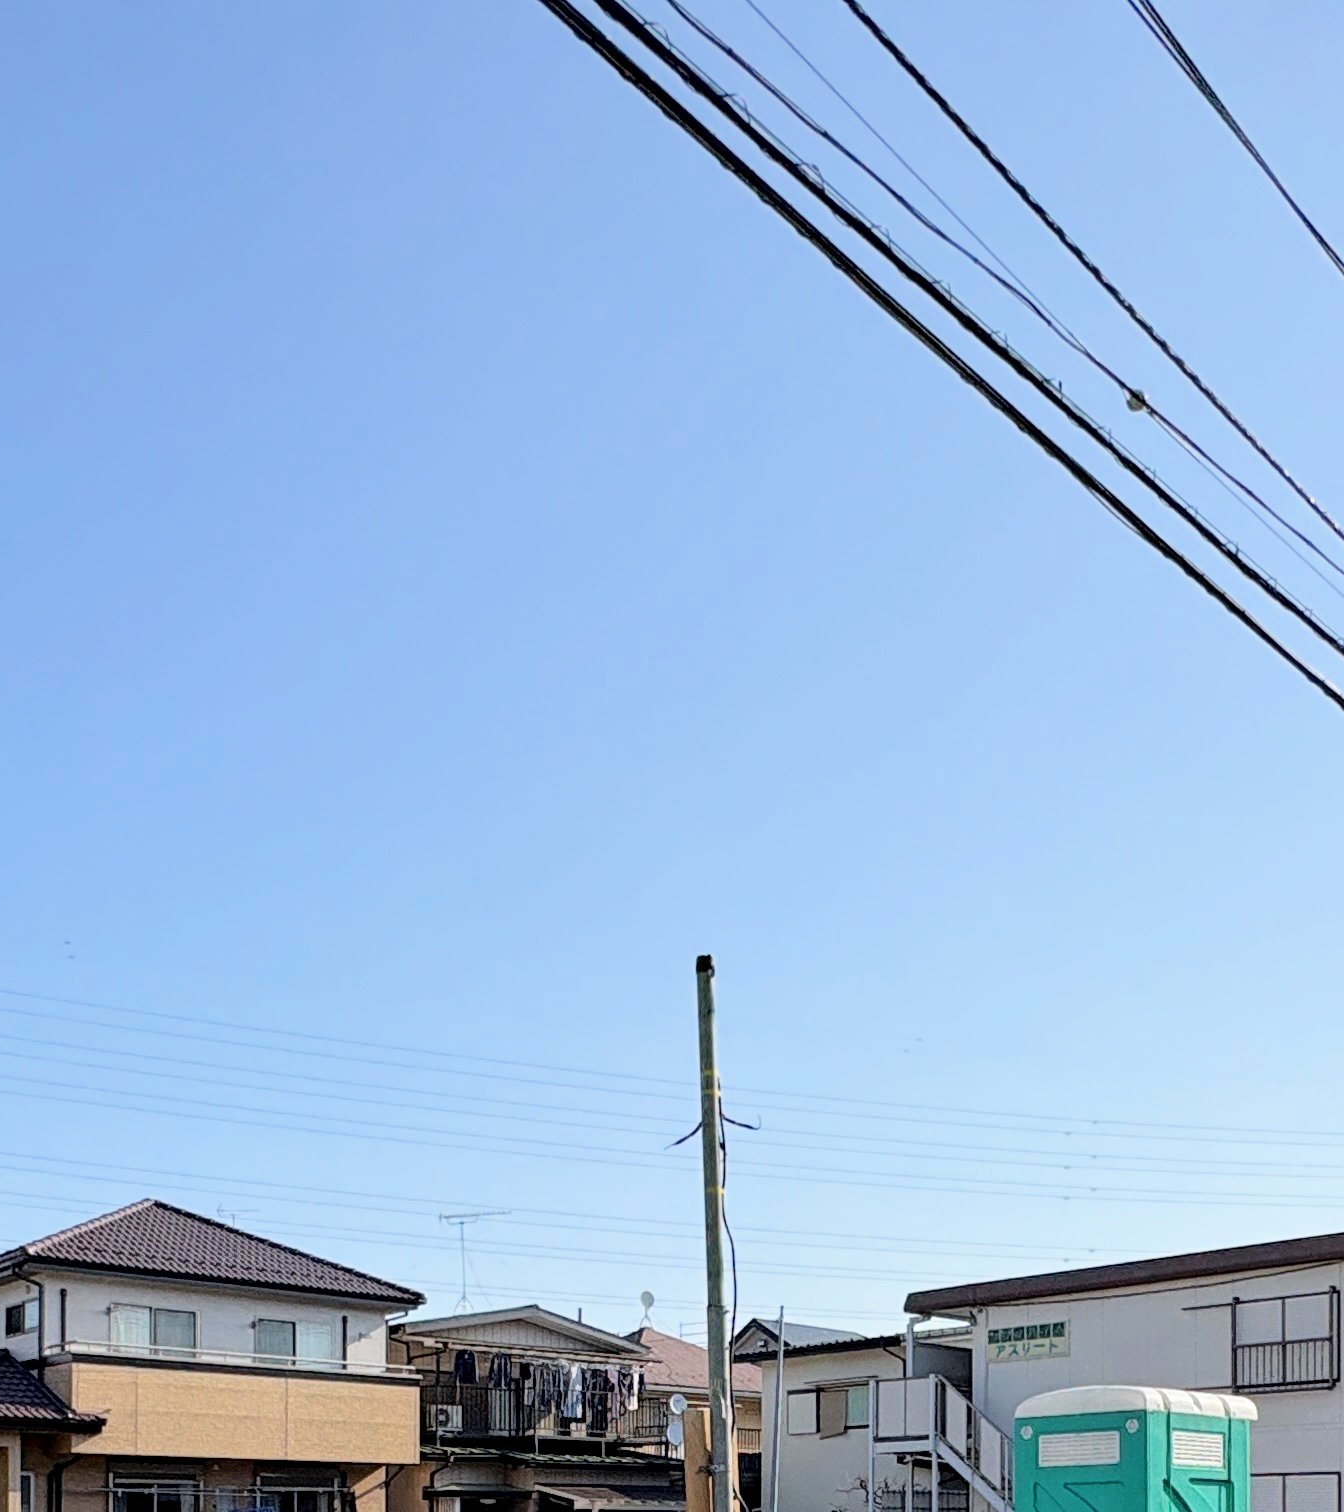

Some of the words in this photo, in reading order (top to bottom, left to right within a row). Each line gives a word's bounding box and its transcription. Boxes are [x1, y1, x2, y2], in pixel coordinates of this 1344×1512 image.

[996, 1339, 1058, 1358] アスリート
